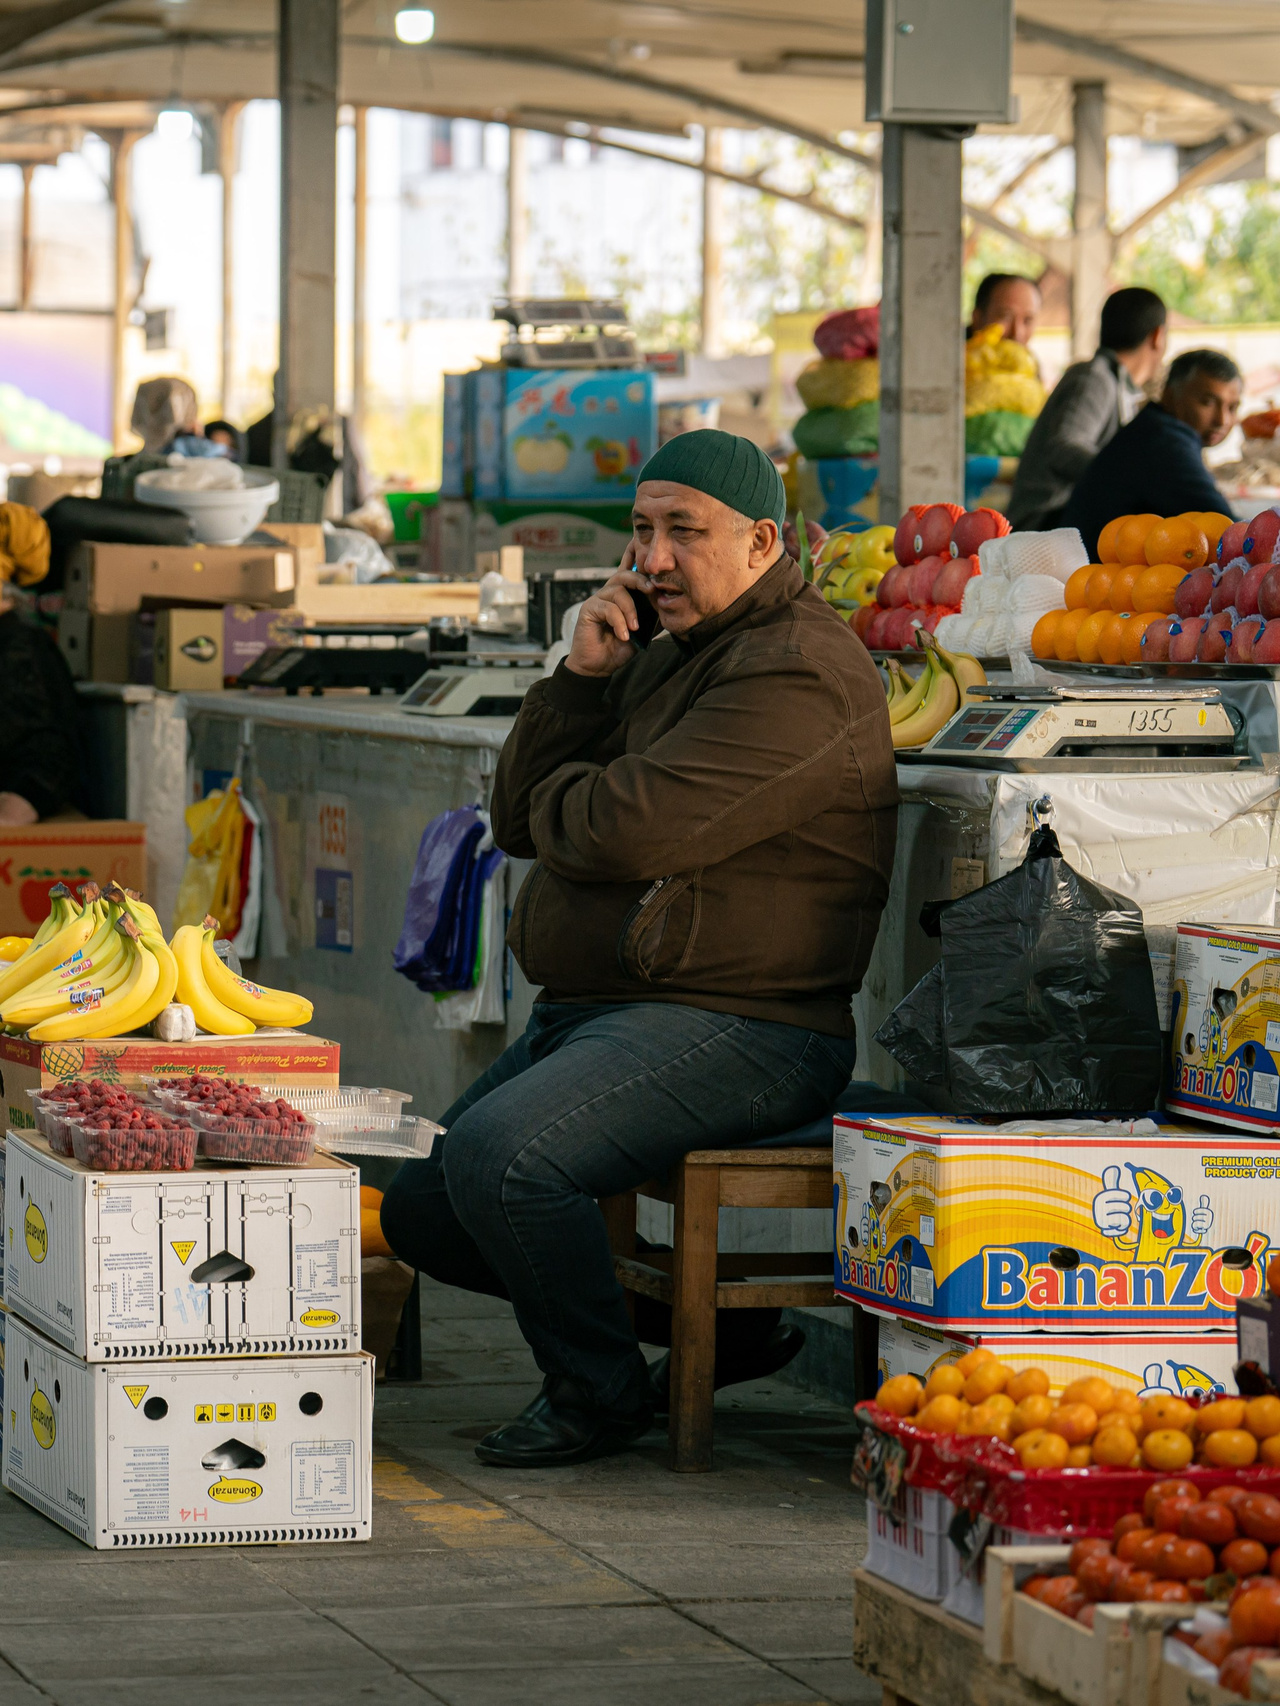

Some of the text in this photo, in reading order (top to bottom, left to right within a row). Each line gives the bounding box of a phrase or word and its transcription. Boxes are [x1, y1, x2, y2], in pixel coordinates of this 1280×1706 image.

[1128, 707, 1177, 735] 1355
[1202, 1156, 1253, 1167] PREMIUM
[1205, 1167, 1258, 1178] PRODUCT
[1259, 1168, 1274, 1179] OF
[302, 1314, 337, 1324] Bonanza!
[212, 1486, 257, 1497] Bonanza!
[179, 1507, 208, 1522] H4
